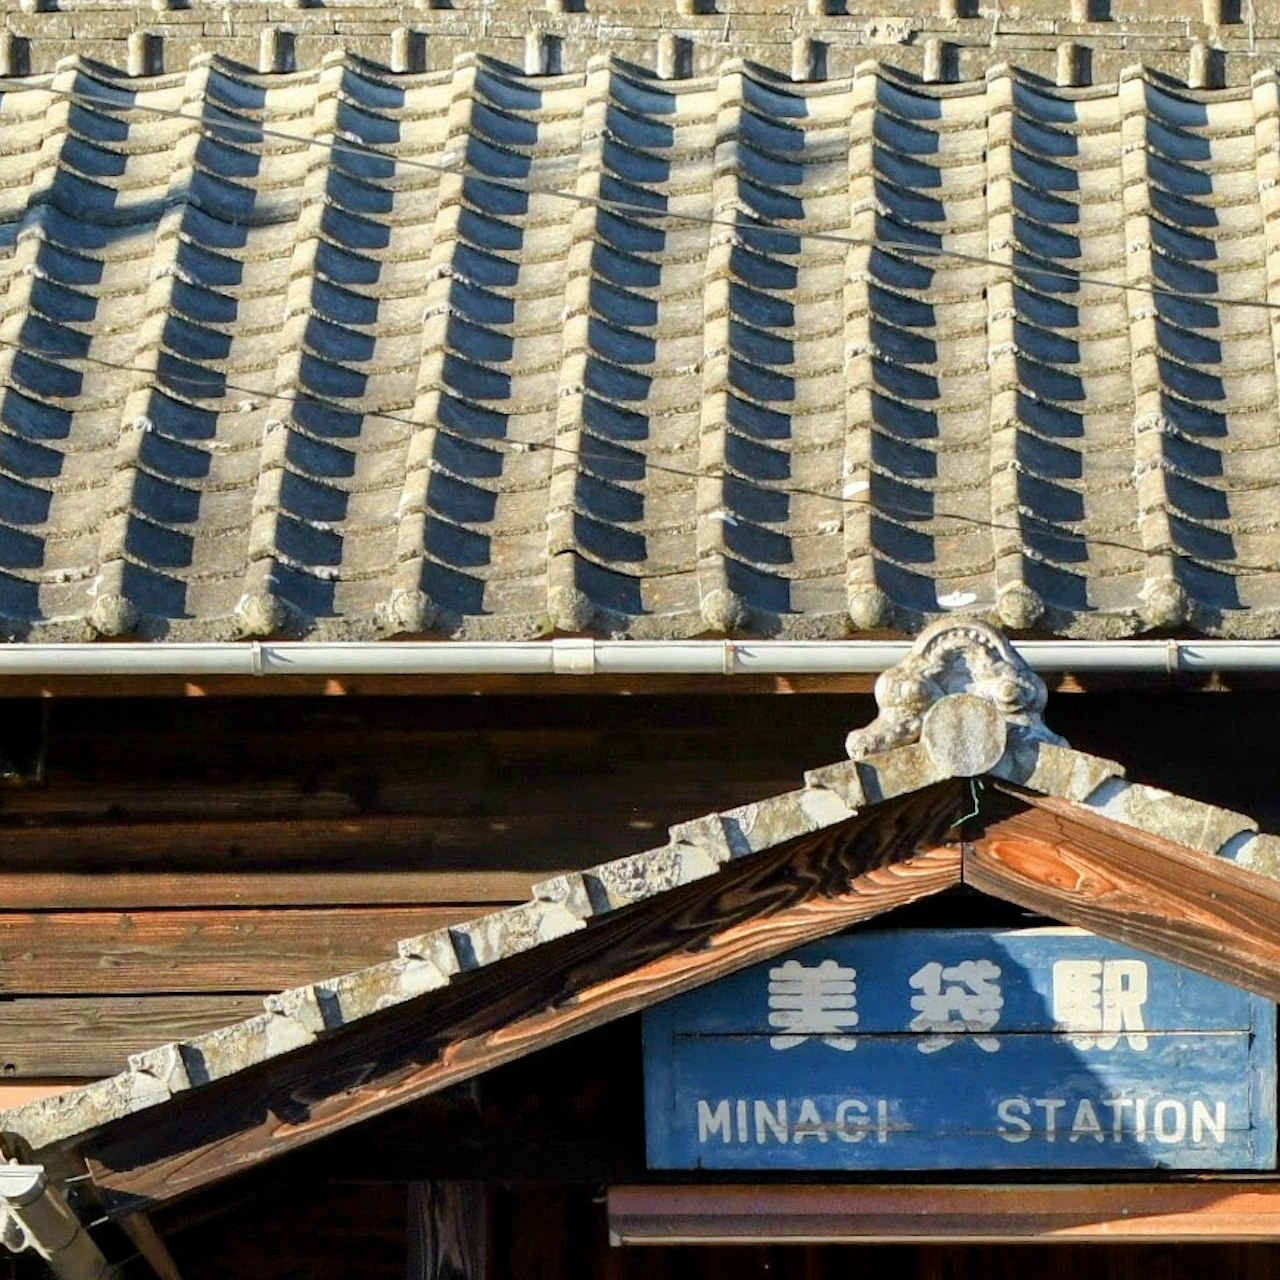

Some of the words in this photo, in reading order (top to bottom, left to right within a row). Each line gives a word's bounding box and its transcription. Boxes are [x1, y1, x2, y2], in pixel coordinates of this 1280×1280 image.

[768, 958, 1149, 1053] 美袋駅
[698, 1099, 888, 1145] MINAGI
[996, 1097, 1228, 1145] STATION
